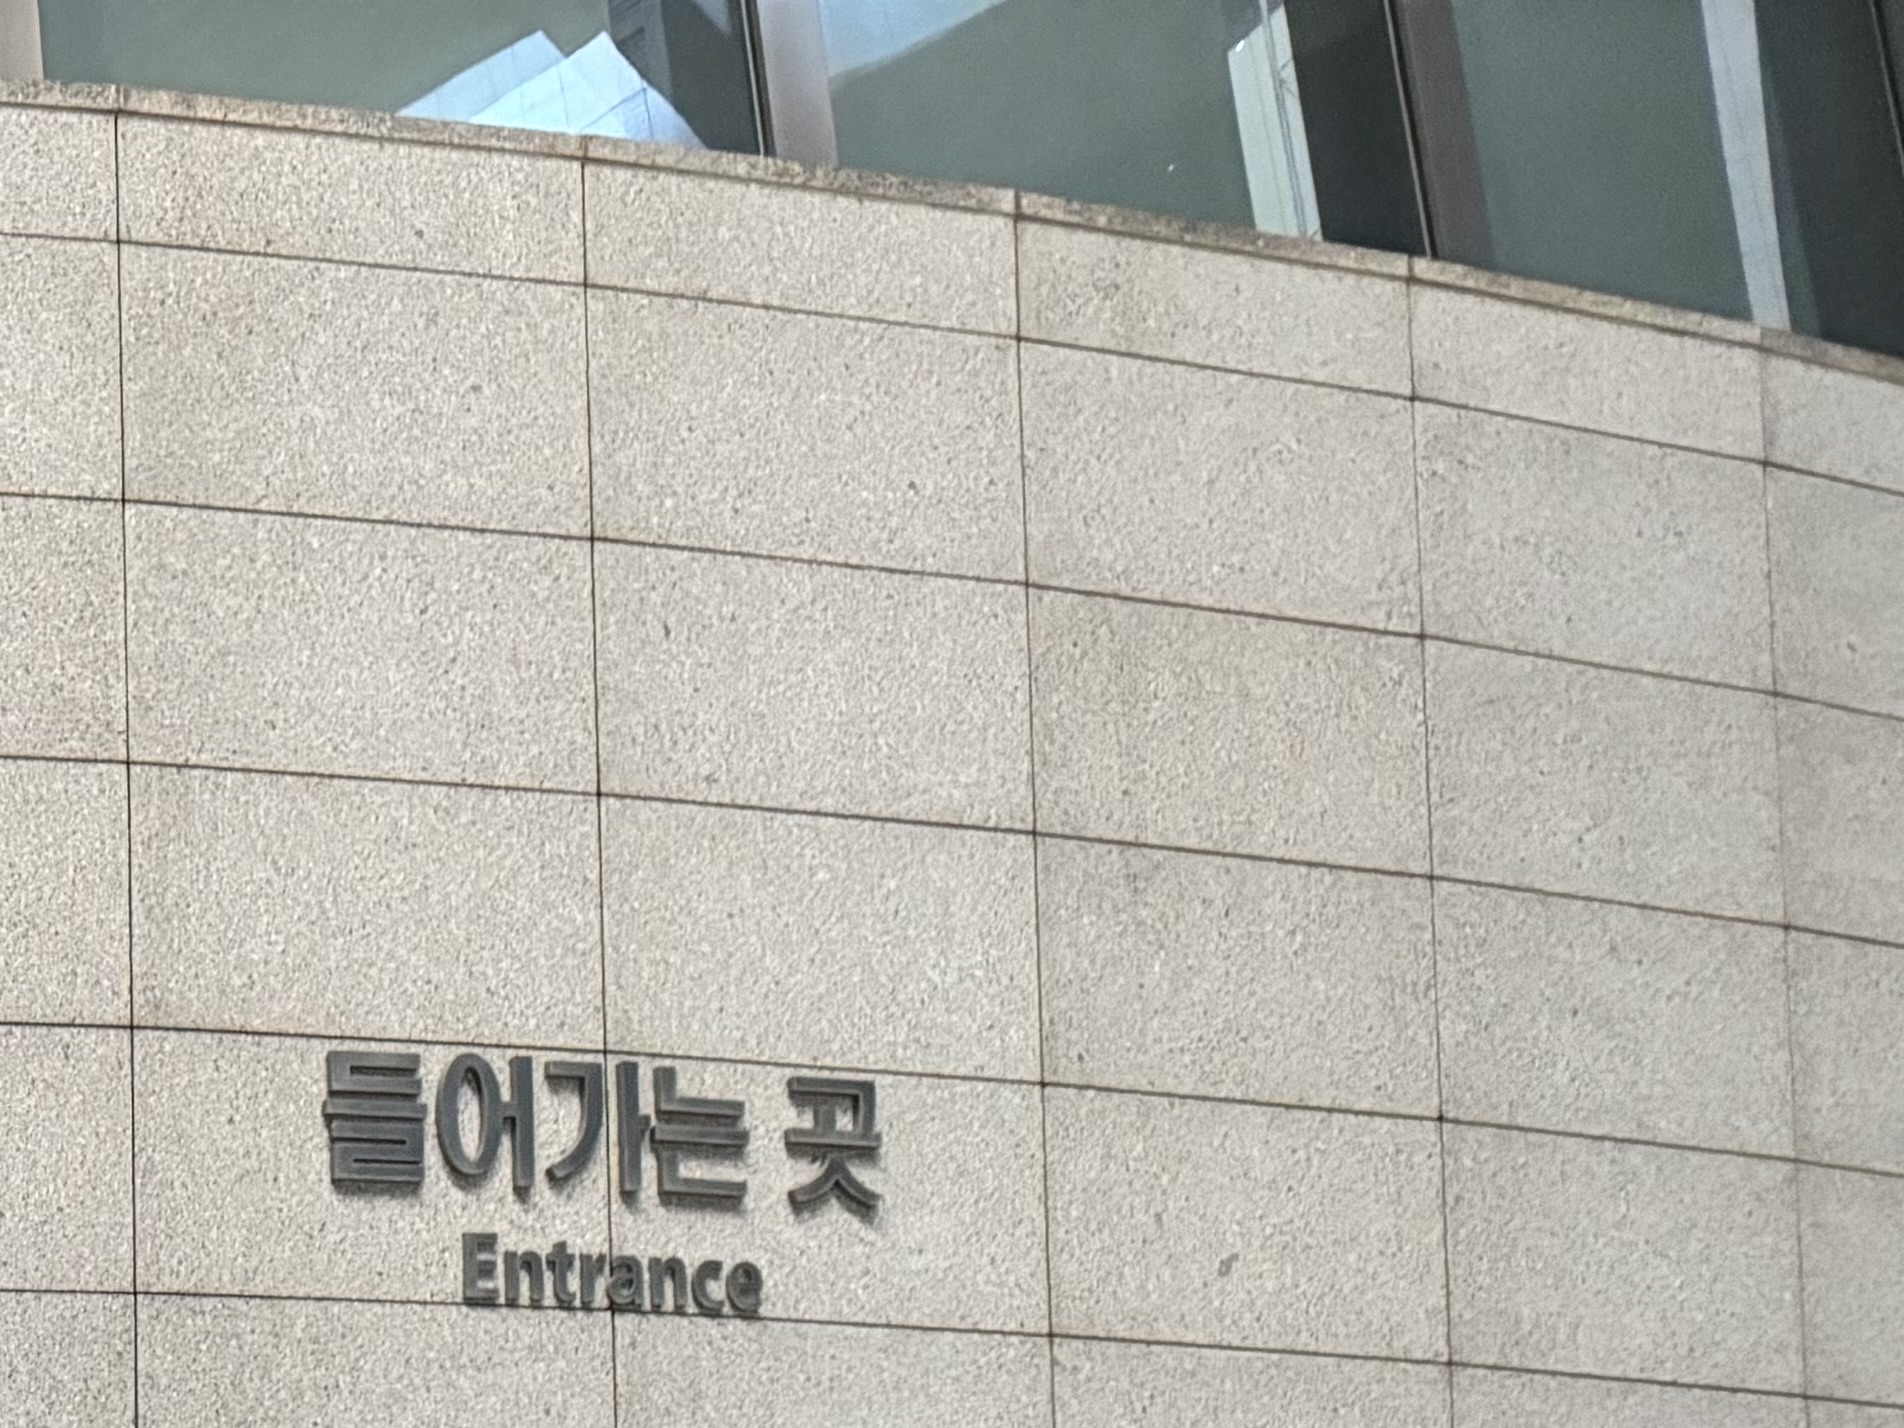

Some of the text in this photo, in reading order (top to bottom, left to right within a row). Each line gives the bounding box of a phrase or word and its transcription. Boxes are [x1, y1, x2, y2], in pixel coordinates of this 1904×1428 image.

[322, 1049, 883, 1222] 들어가는 곳
[461, 1231, 764, 1316] Entrance
